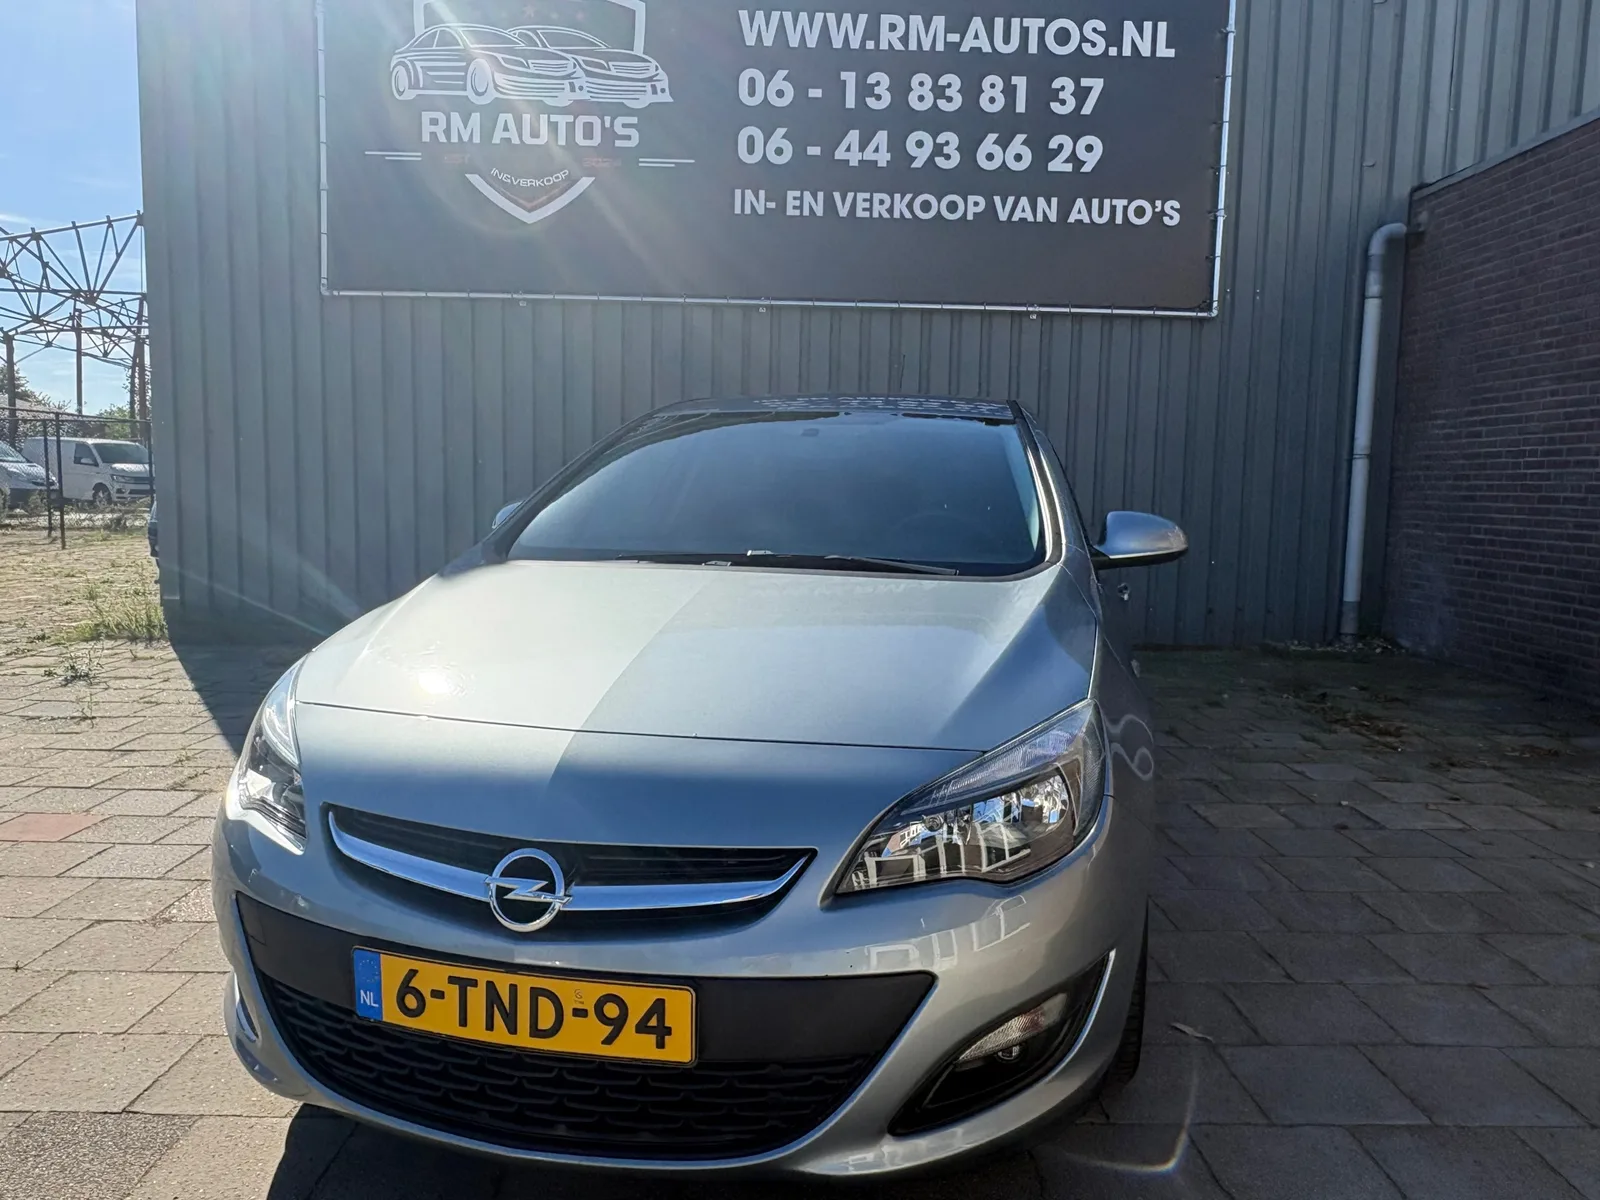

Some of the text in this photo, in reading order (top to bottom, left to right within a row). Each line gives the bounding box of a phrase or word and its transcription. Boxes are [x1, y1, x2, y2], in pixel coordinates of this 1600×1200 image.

[738, 9, 1176, 58] WWW.RM-AUTOS.NL
[738, 68, 1105, 116] 06 - 13 83 81 37
[421, 110, 640, 148] RM AUTO'S
[737, 125, 1104, 173] 06 - 44 93 66 29
[733, 188, 1181, 226] IN- EN VERKOOP VAN AUTO'S
[359, 967, 673, 1050] NL 6-TND-94
